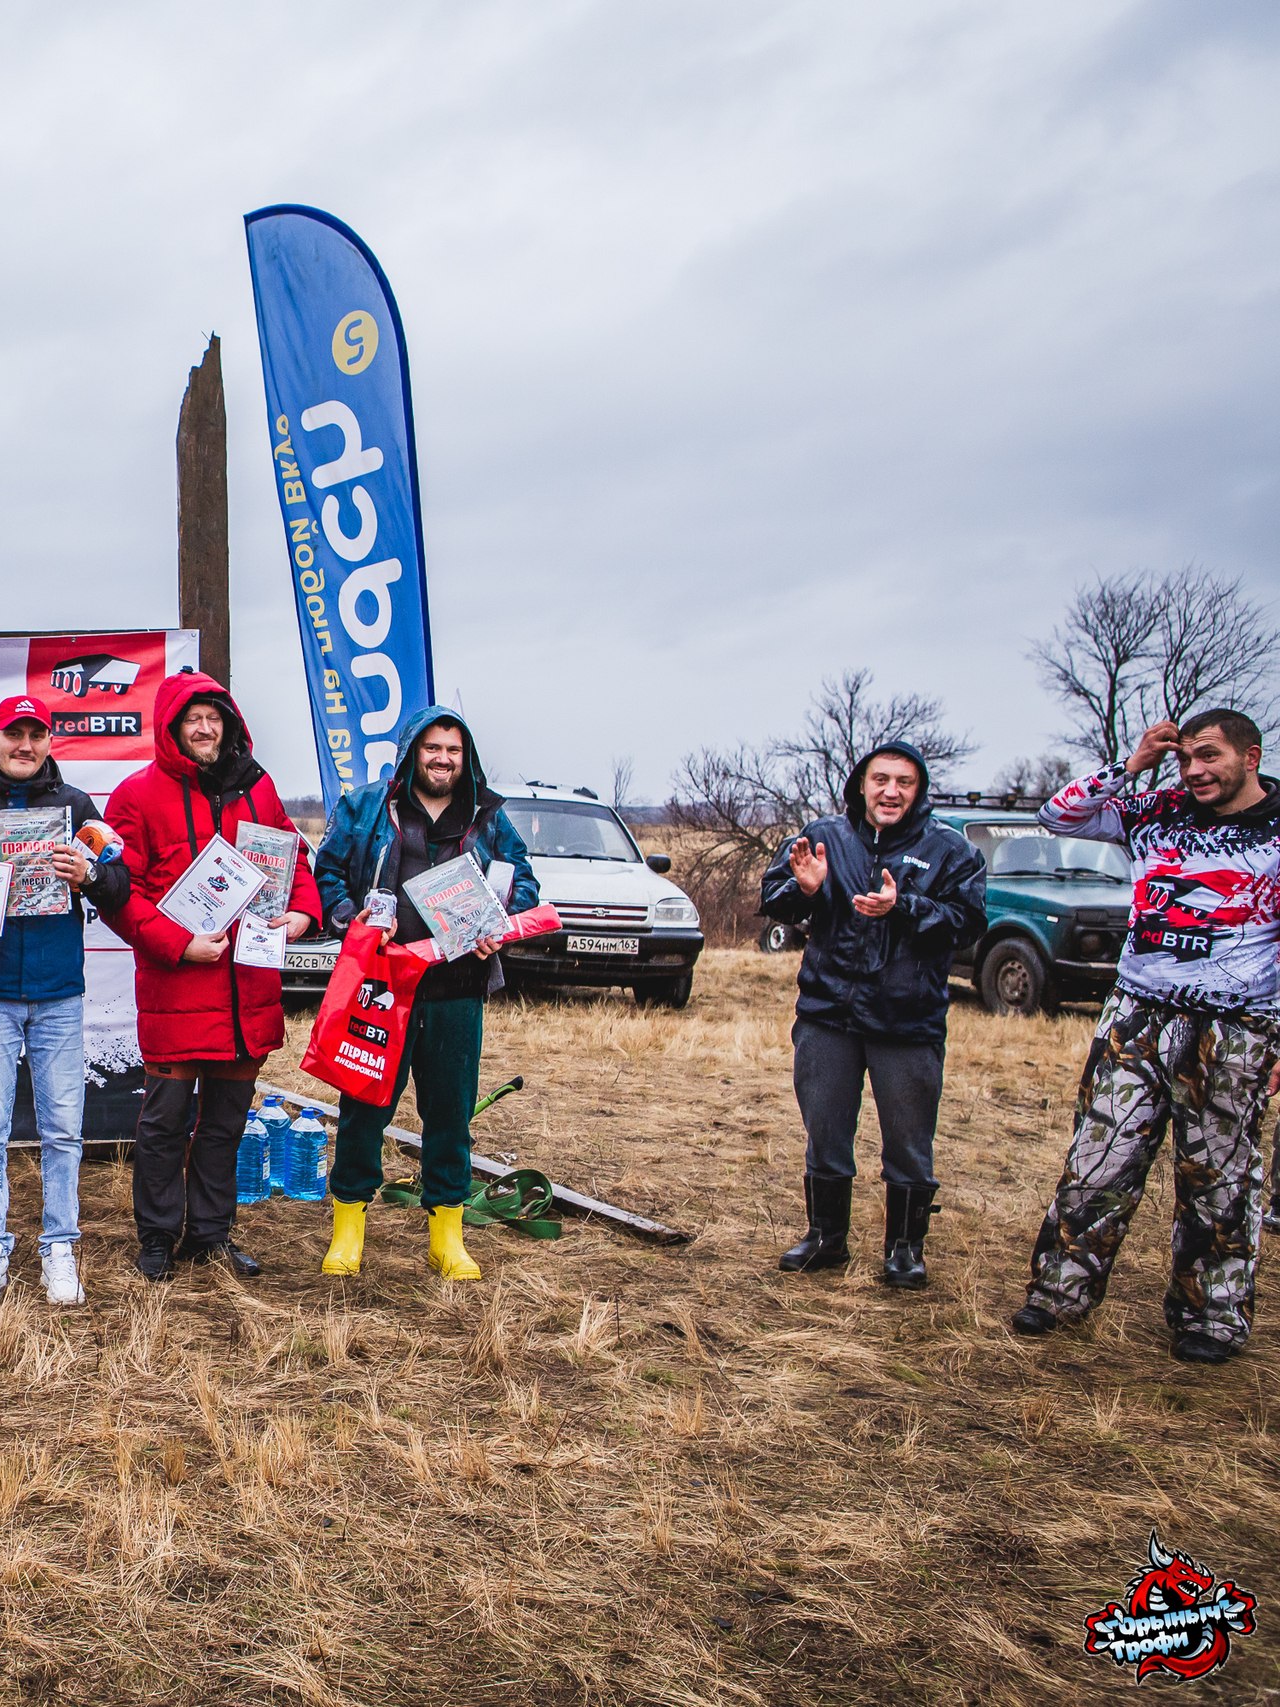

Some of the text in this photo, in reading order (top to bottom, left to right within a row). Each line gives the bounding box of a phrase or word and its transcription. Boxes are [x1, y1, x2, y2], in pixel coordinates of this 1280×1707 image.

[55, 716, 137, 733] redBTR
[1, 840, 56, 855] грамота
[21, 876, 52, 887] место
[424, 880, 474, 908] грамота
[432, 911, 451, 934] 1
[1140, 928, 1210, 952] edBTR
